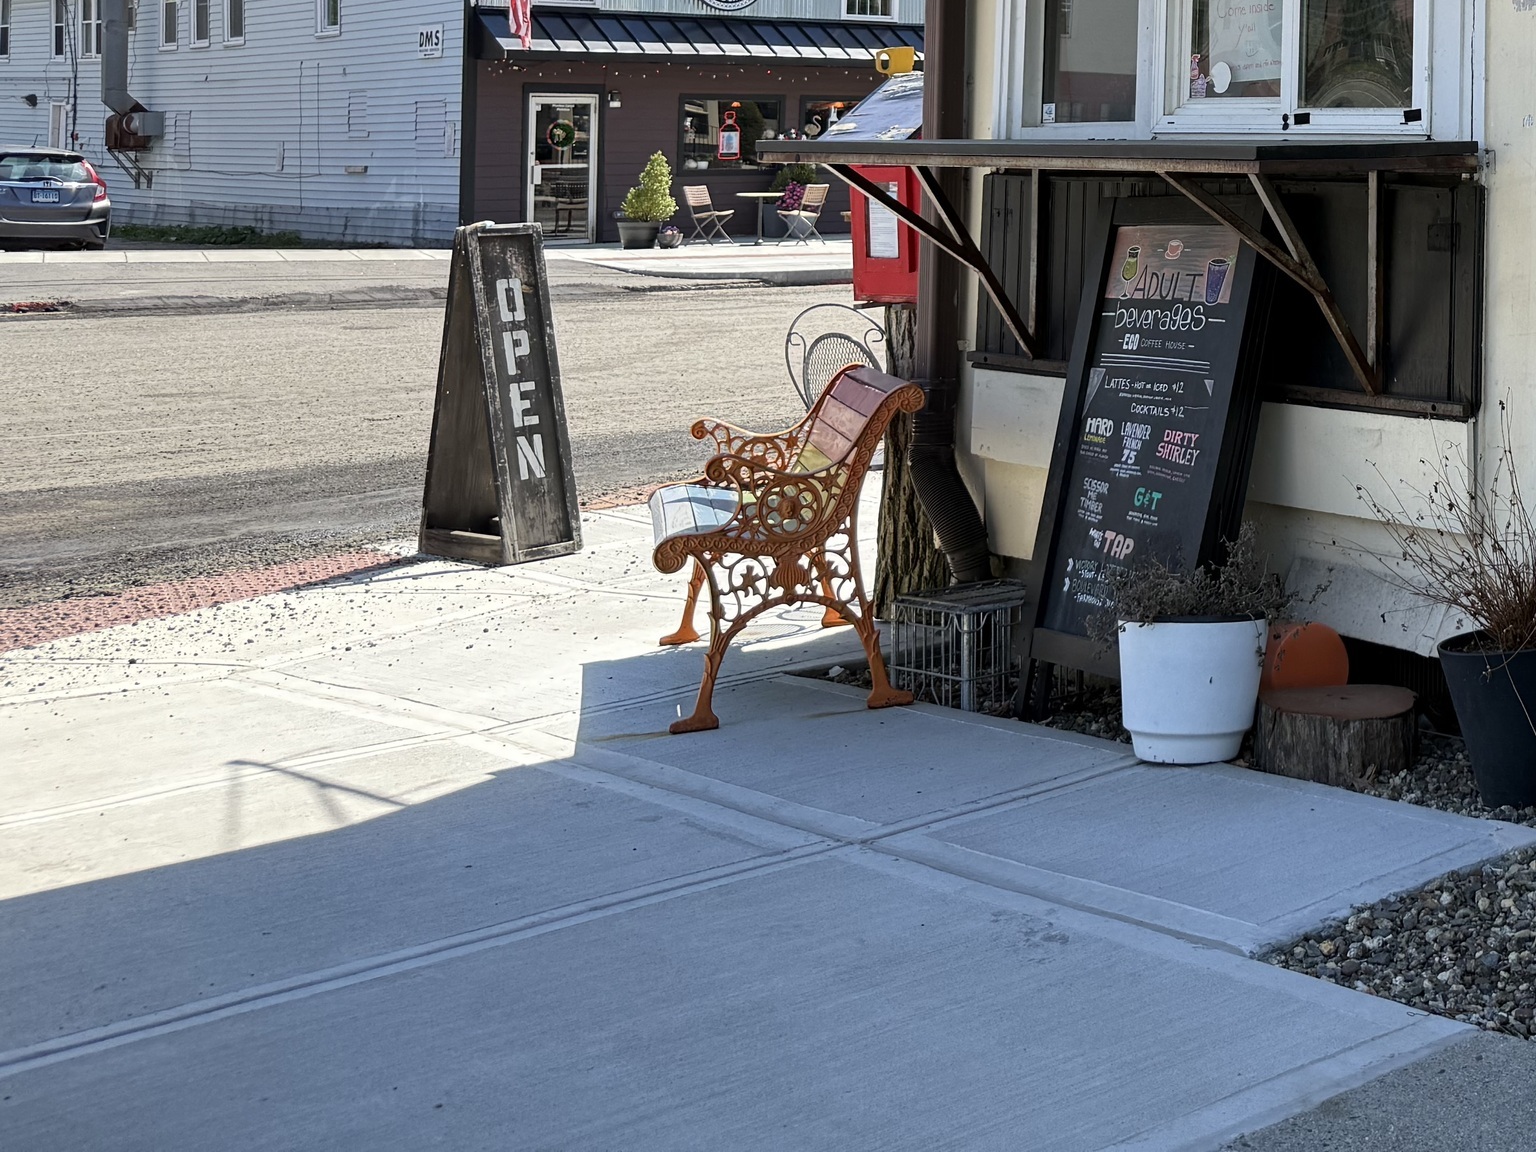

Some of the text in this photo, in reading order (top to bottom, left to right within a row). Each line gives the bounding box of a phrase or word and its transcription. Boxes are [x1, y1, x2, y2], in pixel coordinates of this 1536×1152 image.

[419, 30, 439, 47] DMS
[1131, 264, 1203, 301] ADULT
[1115, 301, 1206, 331] beverages
[1123, 334, 1186, 351] ECO COFFEE HOUSE
[496, 278, 546, 480] OPEN
[1105, 375, 1130, 390] LATTES
[1131, 403, 1170, 417] COCKTAILS
[1086, 417, 1114, 437] HARD
[1121, 421, 1151, 440] LAVENDER
[1163, 429, 1199, 447] DIRTY
[1121, 450, 1137, 464] 75
[1156, 443, 1200, 466] SHIRLEY
[1084, 477, 1109, 494] SCISSOR
[1080, 496, 1103, 513] TIMBER
[1134, 487, 1162, 510] G&T
[1104, 530, 1135, 560] TAP
